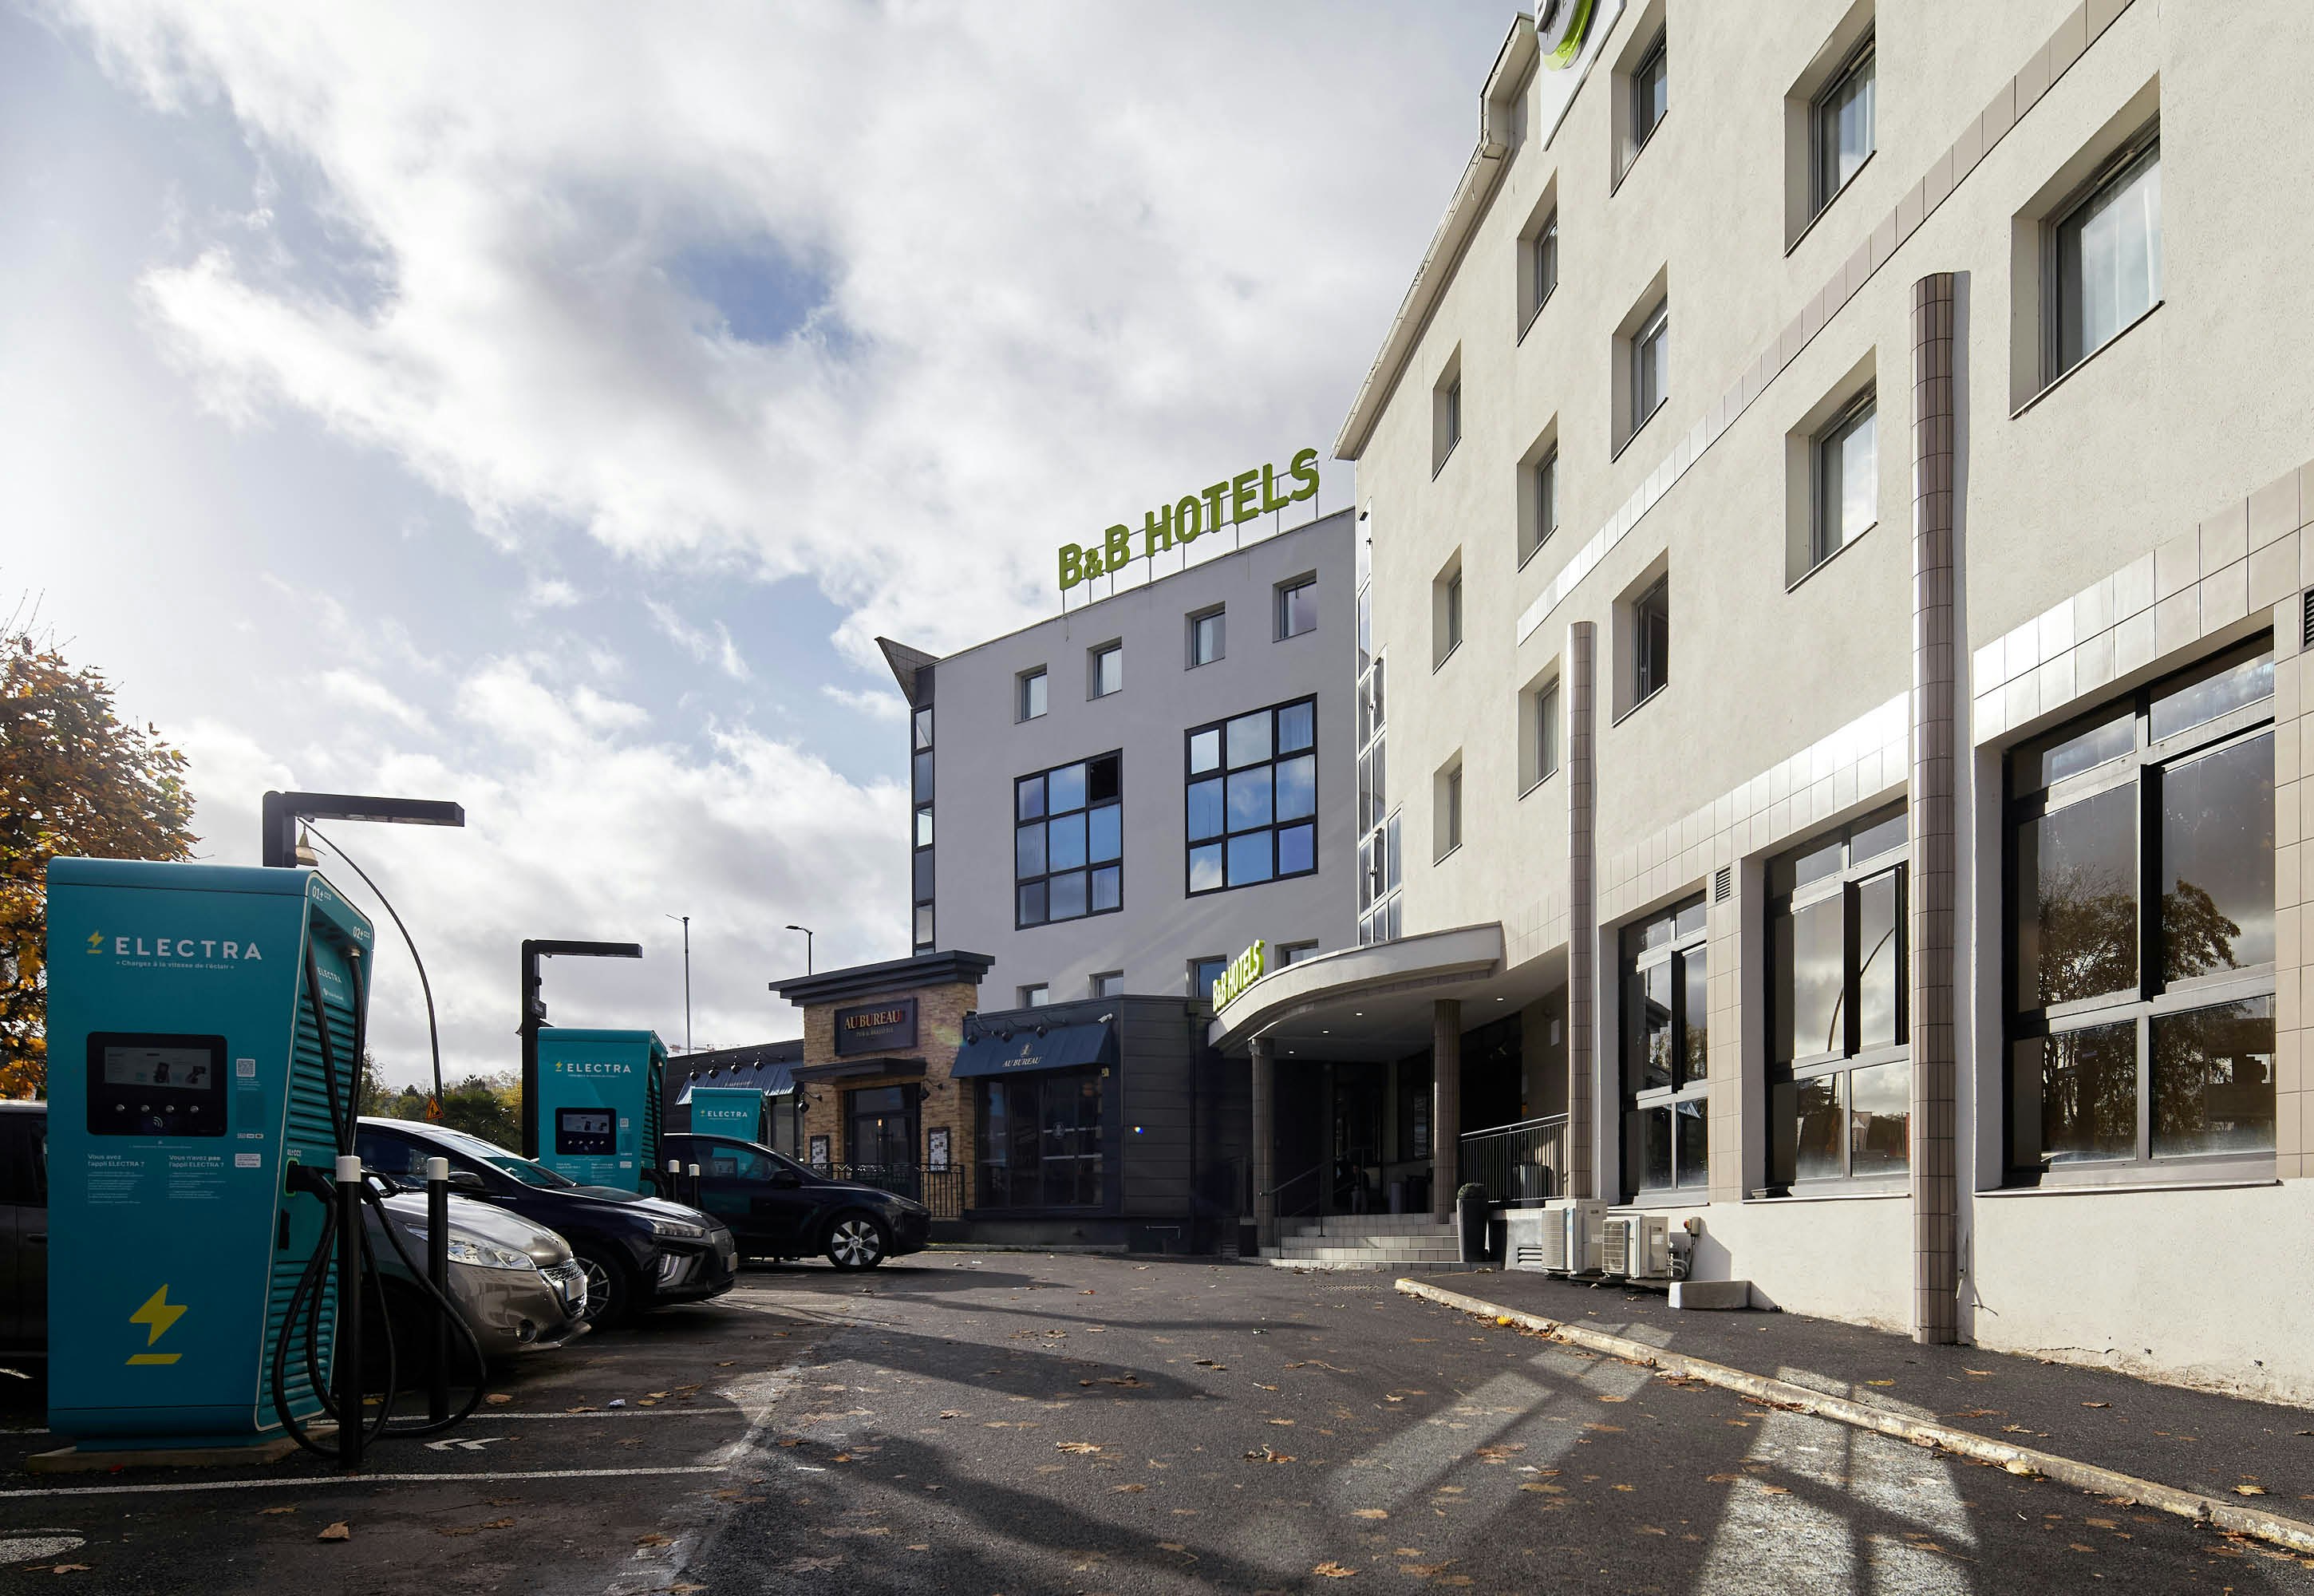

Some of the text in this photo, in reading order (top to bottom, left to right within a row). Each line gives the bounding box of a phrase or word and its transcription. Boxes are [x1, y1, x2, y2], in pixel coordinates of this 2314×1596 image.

[1059, 448, 1321, 591] B&B HOTELS
[116, 936, 263, 961] ELECTRA
[318, 967, 342, 984] ELECTRA
[1213, 939, 1265, 1013] B&B HOTELS
[844, 1009, 901, 1029] AU BUREAU
[567, 1063, 631, 1073] ELECTRA
[1013, 1056, 1041, 1066] BUREAU
